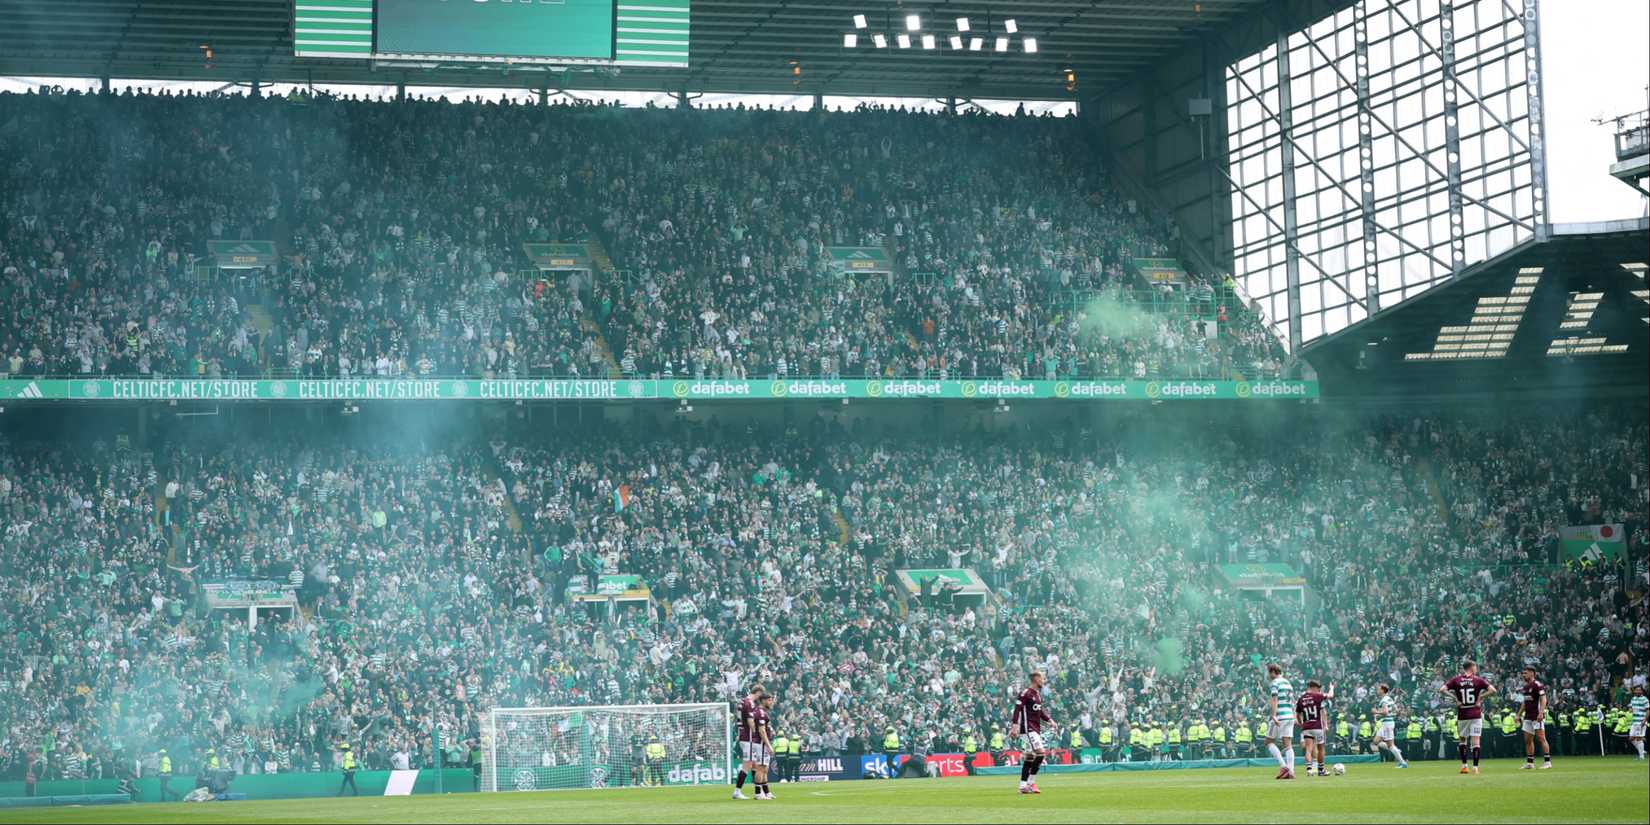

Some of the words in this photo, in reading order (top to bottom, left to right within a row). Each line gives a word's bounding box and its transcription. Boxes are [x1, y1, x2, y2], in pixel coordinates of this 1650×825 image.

[113, 381, 258, 398] CELTICFC.NET/STORE
[300, 381, 440, 399] CELTICFC.NET/STORE
[480, 381, 616, 398] CELTICFC.NET/STORE
[691, 381, 749, 396] dafabet
[789, 381, 846, 396] dafabet
[884, 381, 941, 396] dafabet
[979, 381, 1034, 396] dafabet
[1071, 382, 1127, 397] dafabet
[1162, 382, 1217, 397] dafabet
[1252, 382, 1305, 396] dafabet
[1460, 688, 1475, 704] 16
[1304, 705, 1317, 720] 14
[817, 758, 844, 771] HILL
[667, 763, 743, 784] dafab
